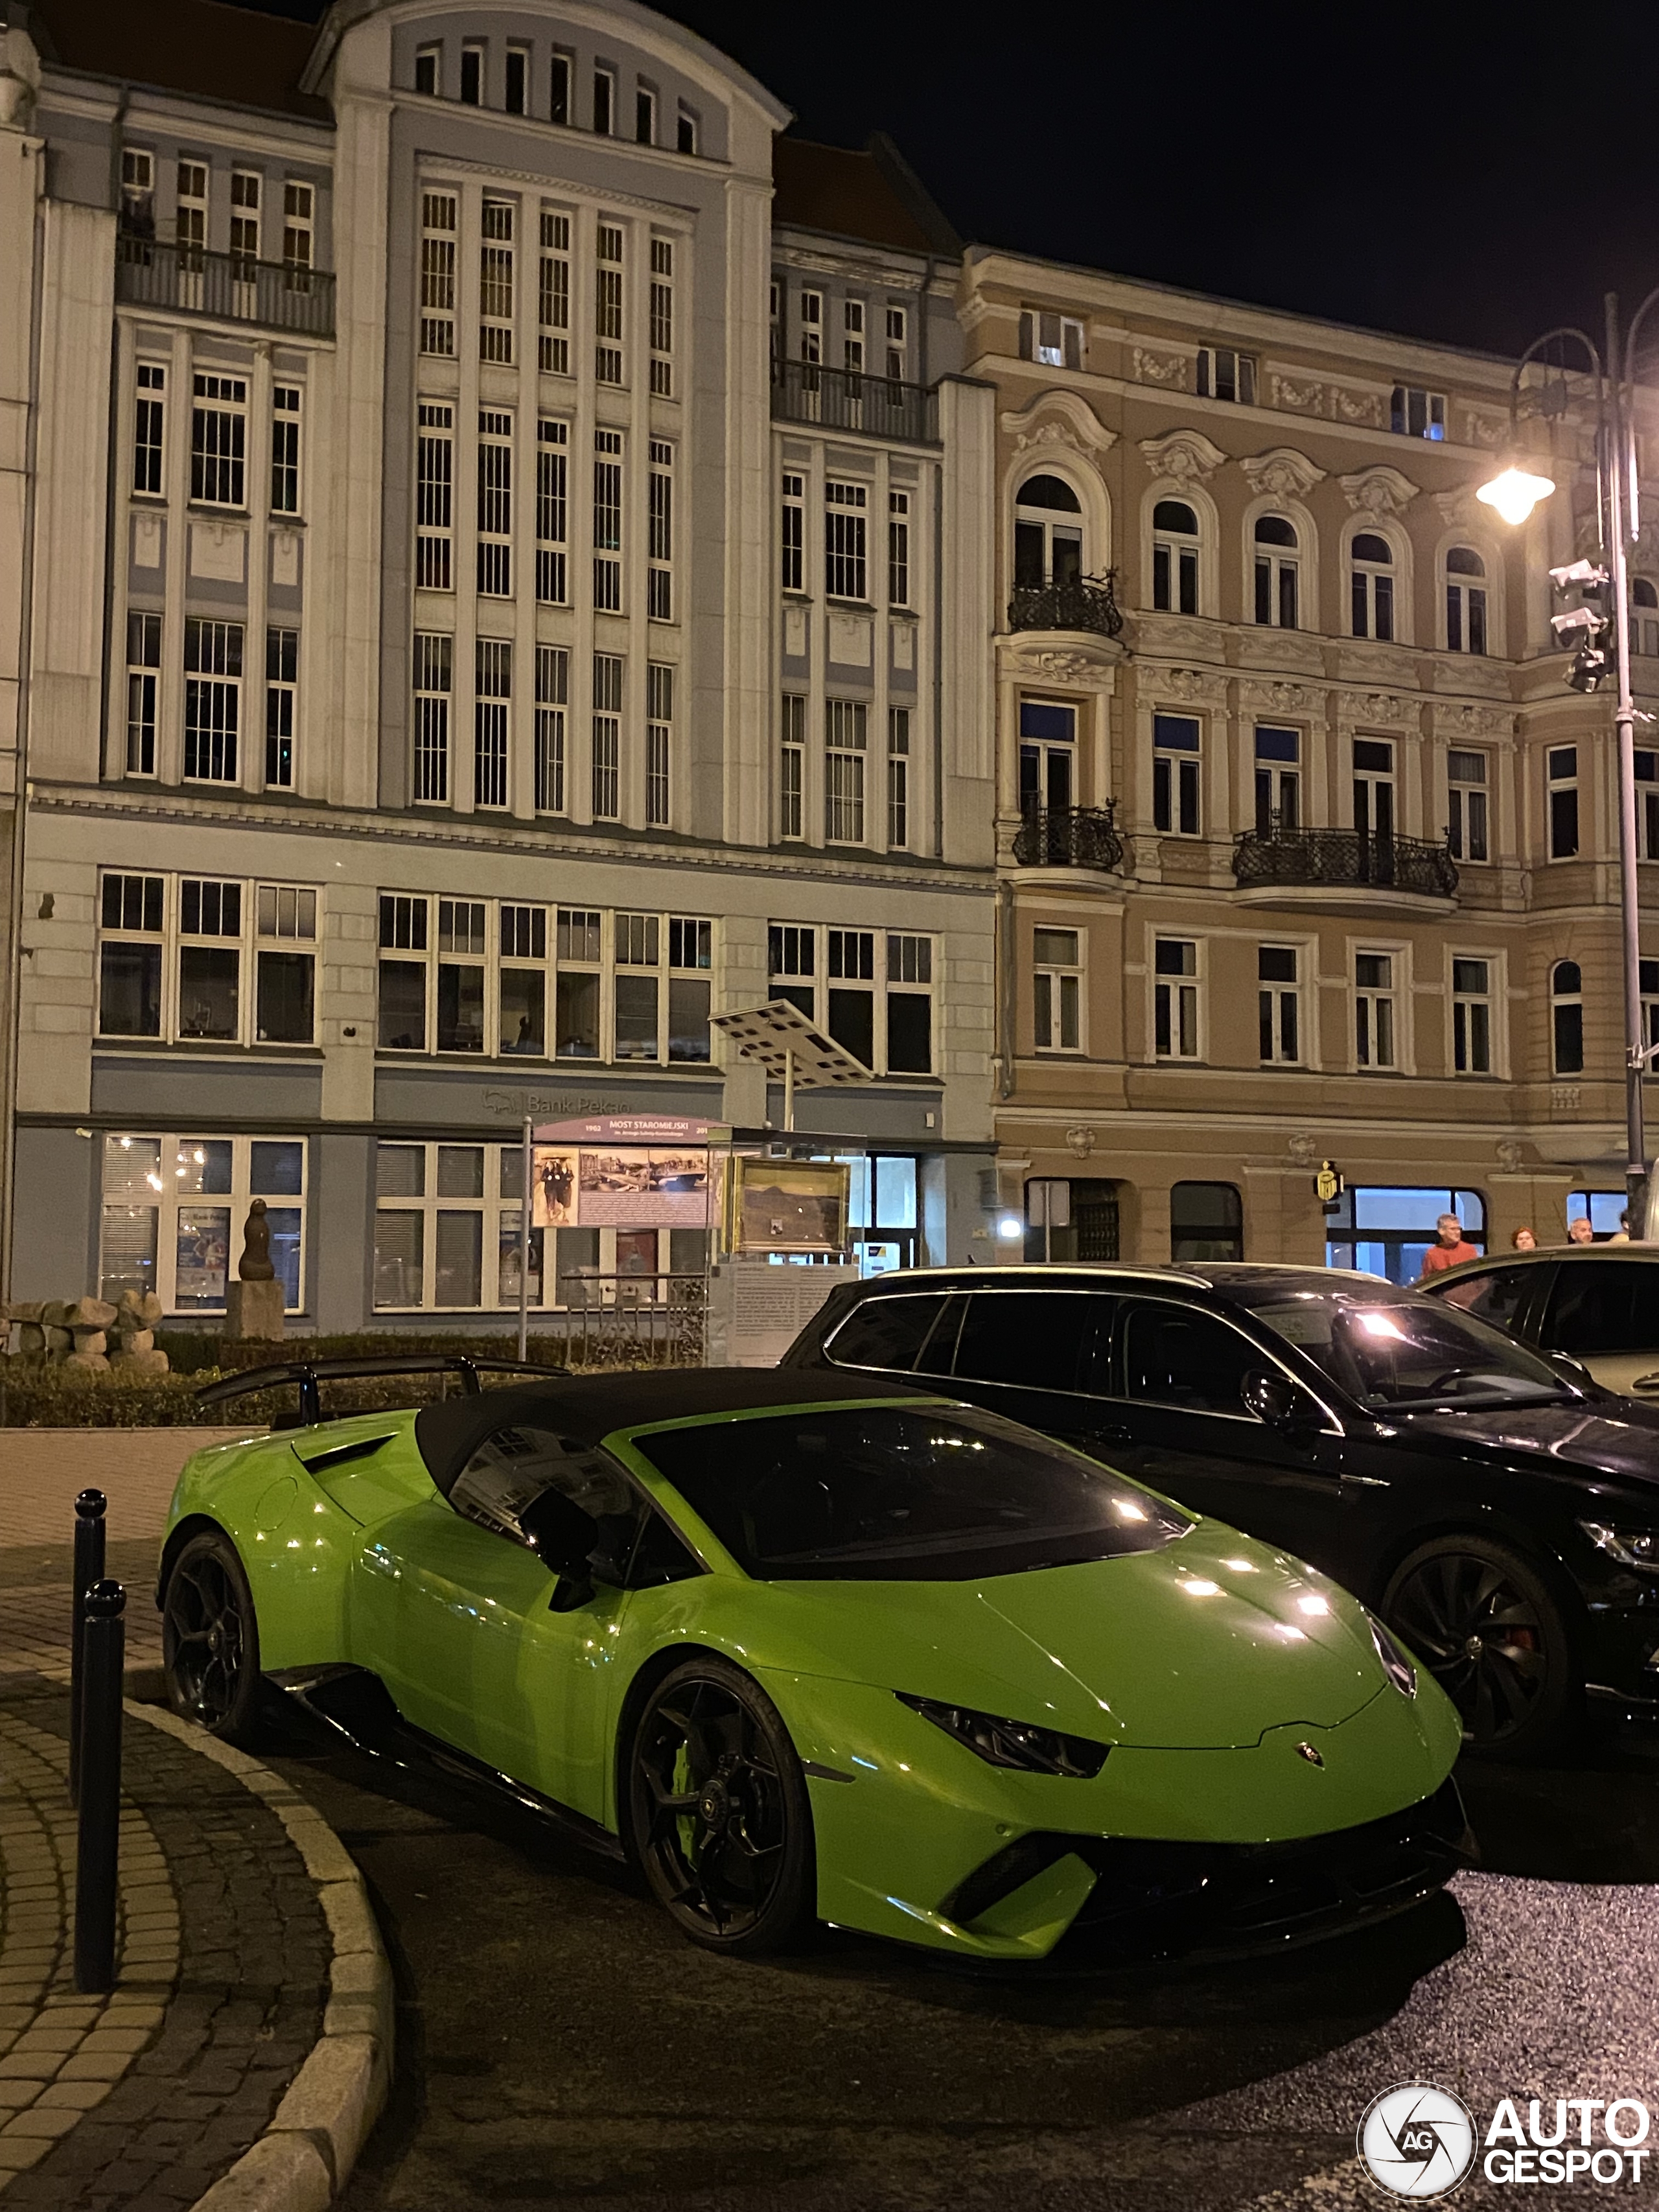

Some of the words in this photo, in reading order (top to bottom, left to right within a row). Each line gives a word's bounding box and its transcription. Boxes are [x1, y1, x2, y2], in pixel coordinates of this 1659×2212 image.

[528, 1094, 572, 1113] Bank
[577, 1097, 631, 1114] Pekao
[609, 1120, 632, 1128] MOST
[634, 1121, 689, 1130] STAROMIEJSKI
